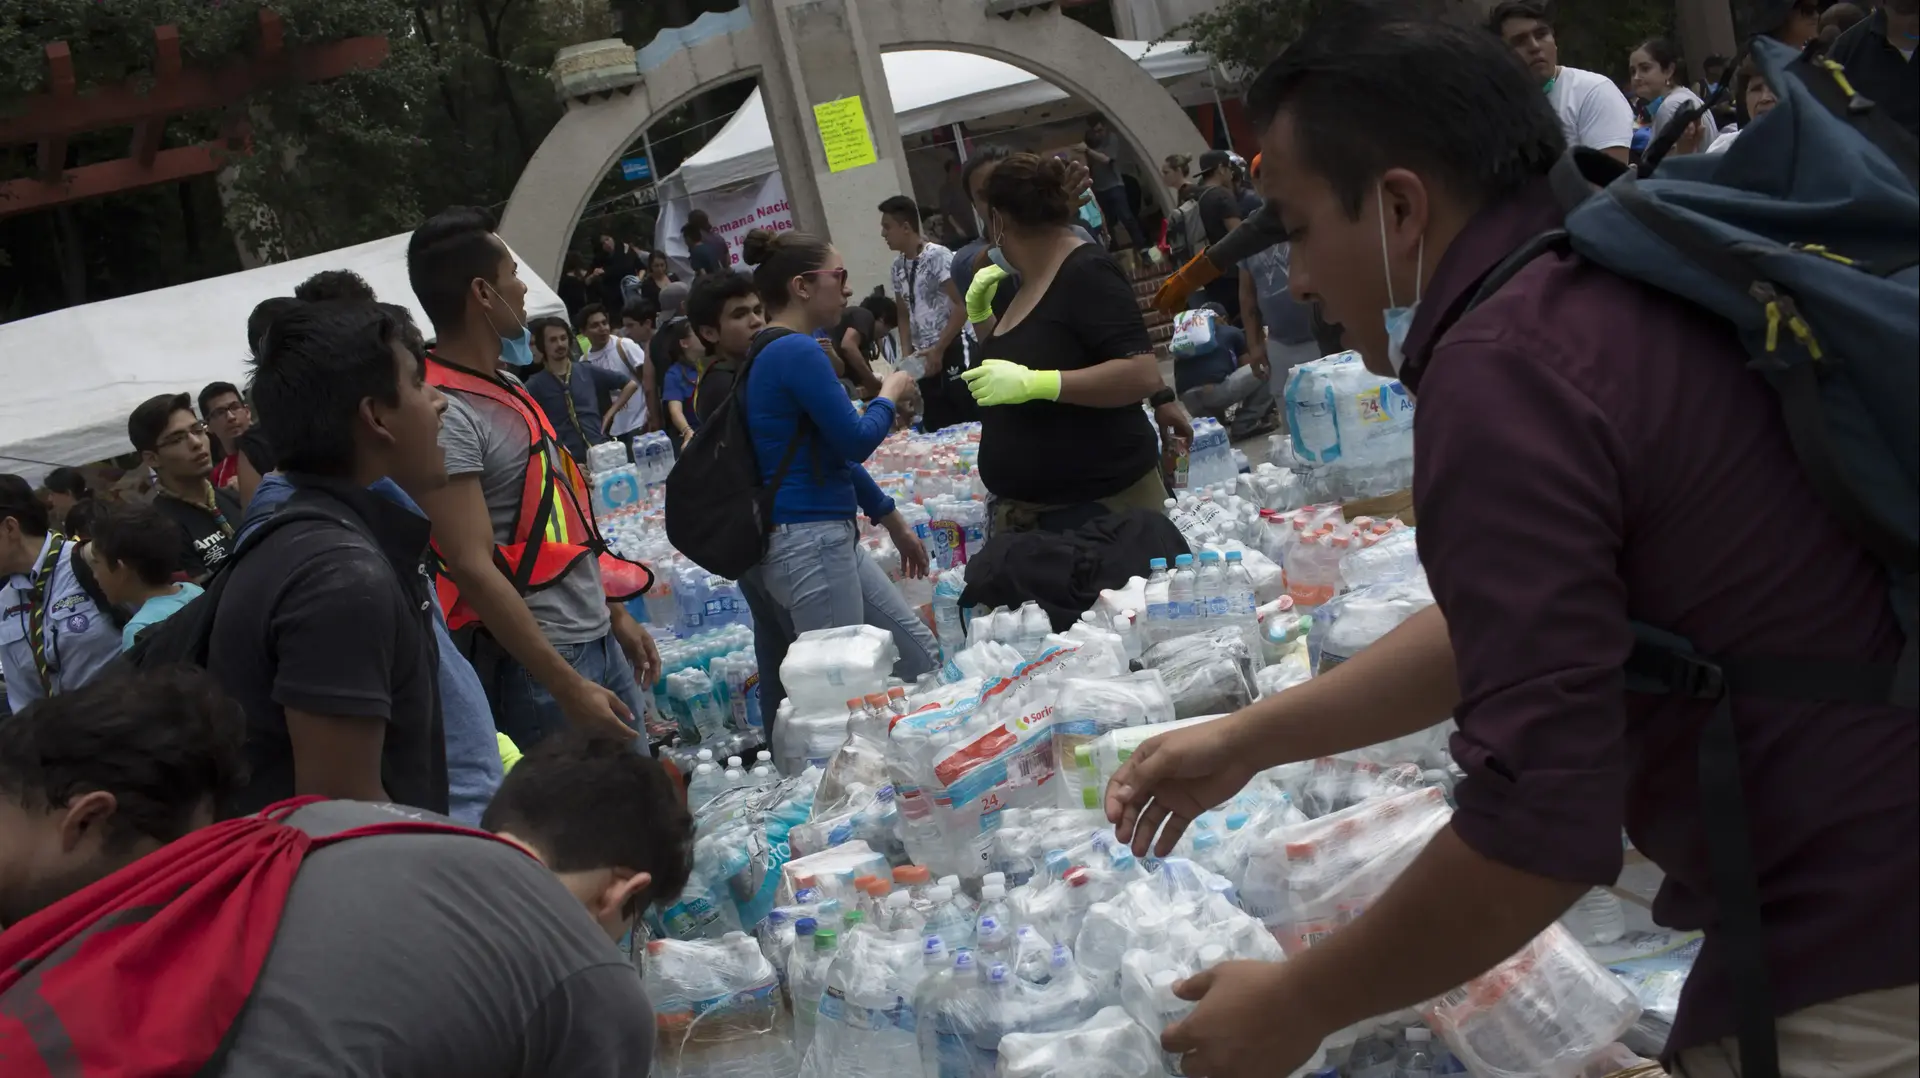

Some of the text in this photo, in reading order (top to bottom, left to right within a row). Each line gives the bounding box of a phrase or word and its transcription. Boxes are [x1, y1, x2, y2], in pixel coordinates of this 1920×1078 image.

[710, 214, 754, 234] emana
[947, 529, 954, 541] 8
[981, 793, 999, 811] 24
